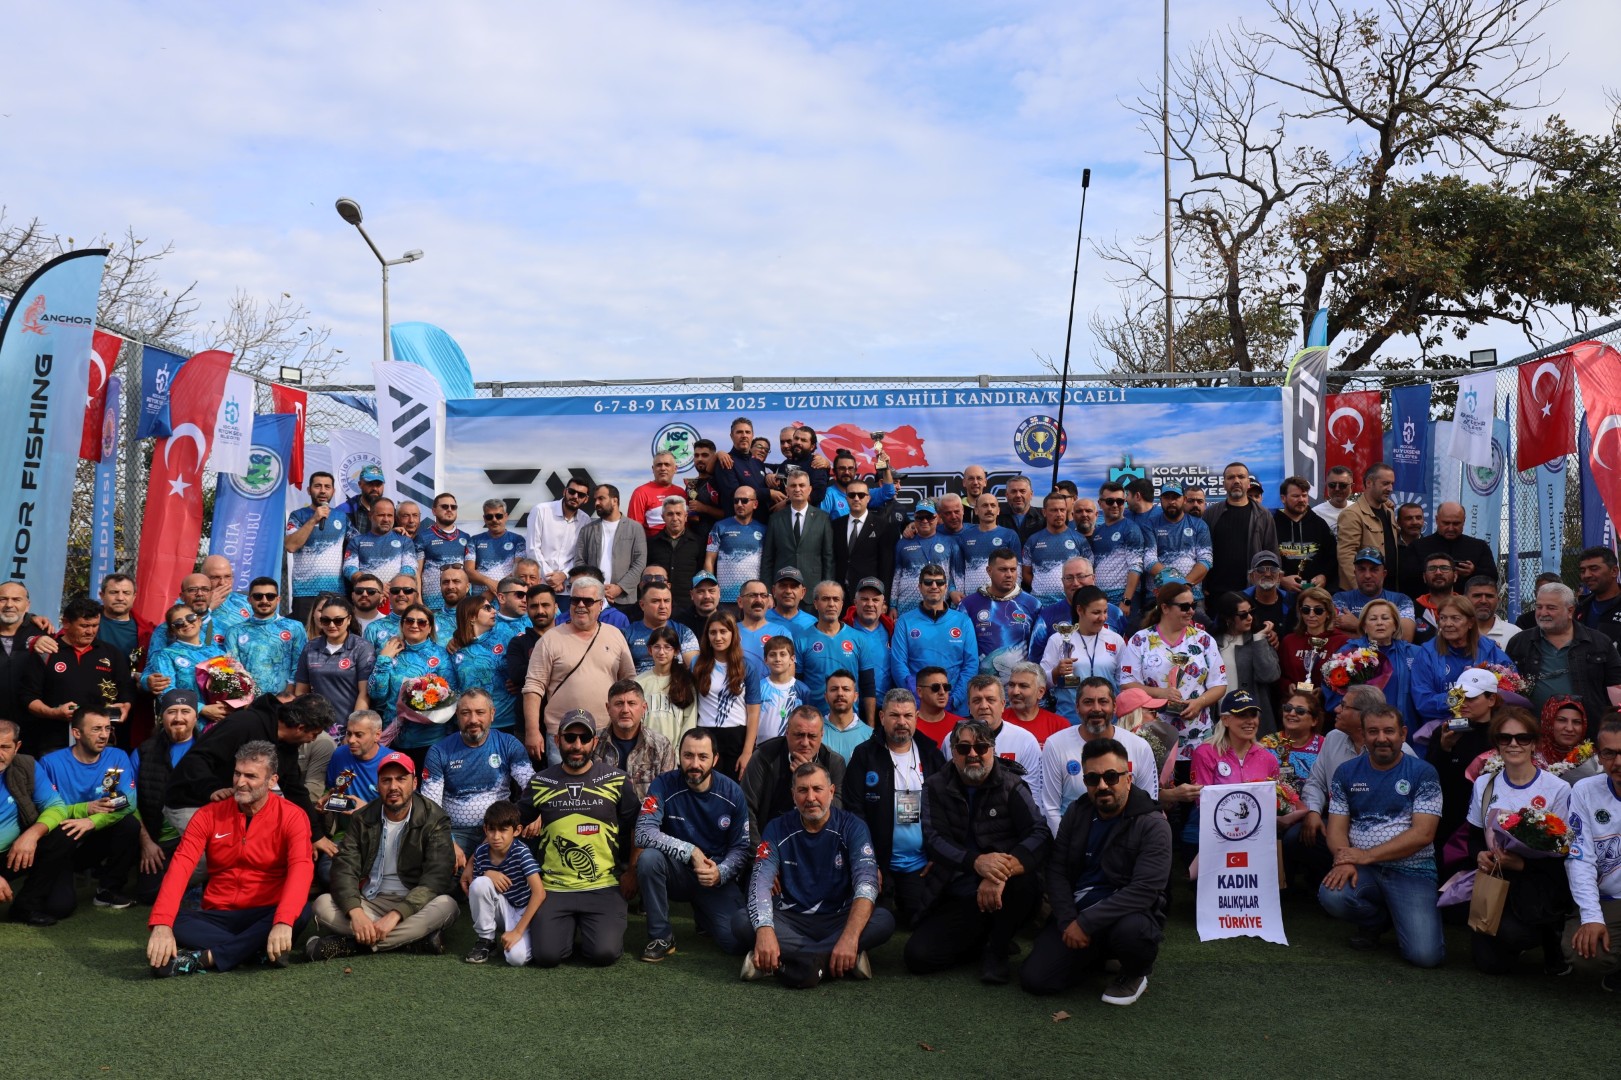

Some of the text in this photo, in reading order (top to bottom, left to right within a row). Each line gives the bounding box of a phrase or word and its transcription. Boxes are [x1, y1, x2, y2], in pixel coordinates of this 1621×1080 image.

[40, 314, 92, 325] ANCHOR
[594, 400, 655, 412] 6-7-8-9
[661, 398, 720, 411] KASIM
[726, 397, 766, 409] 2025
[785, 395, 879, 408] UZUNKUM
[885, 391, 948, 406] SAHİLİ
[21, 353, 54, 490] FISHING
[667, 431, 689, 442] KSC
[223, 522, 241, 556] OLTA
[242, 512, 262, 566] KULÜBÜ
[548, 799, 604, 807] TUTANGALAR
[1217, 874, 1258, 889] KADIN
[1218, 895, 1260, 912] BALIKÇILAR
[1218, 914, 1263, 929] TÜRKİYE
